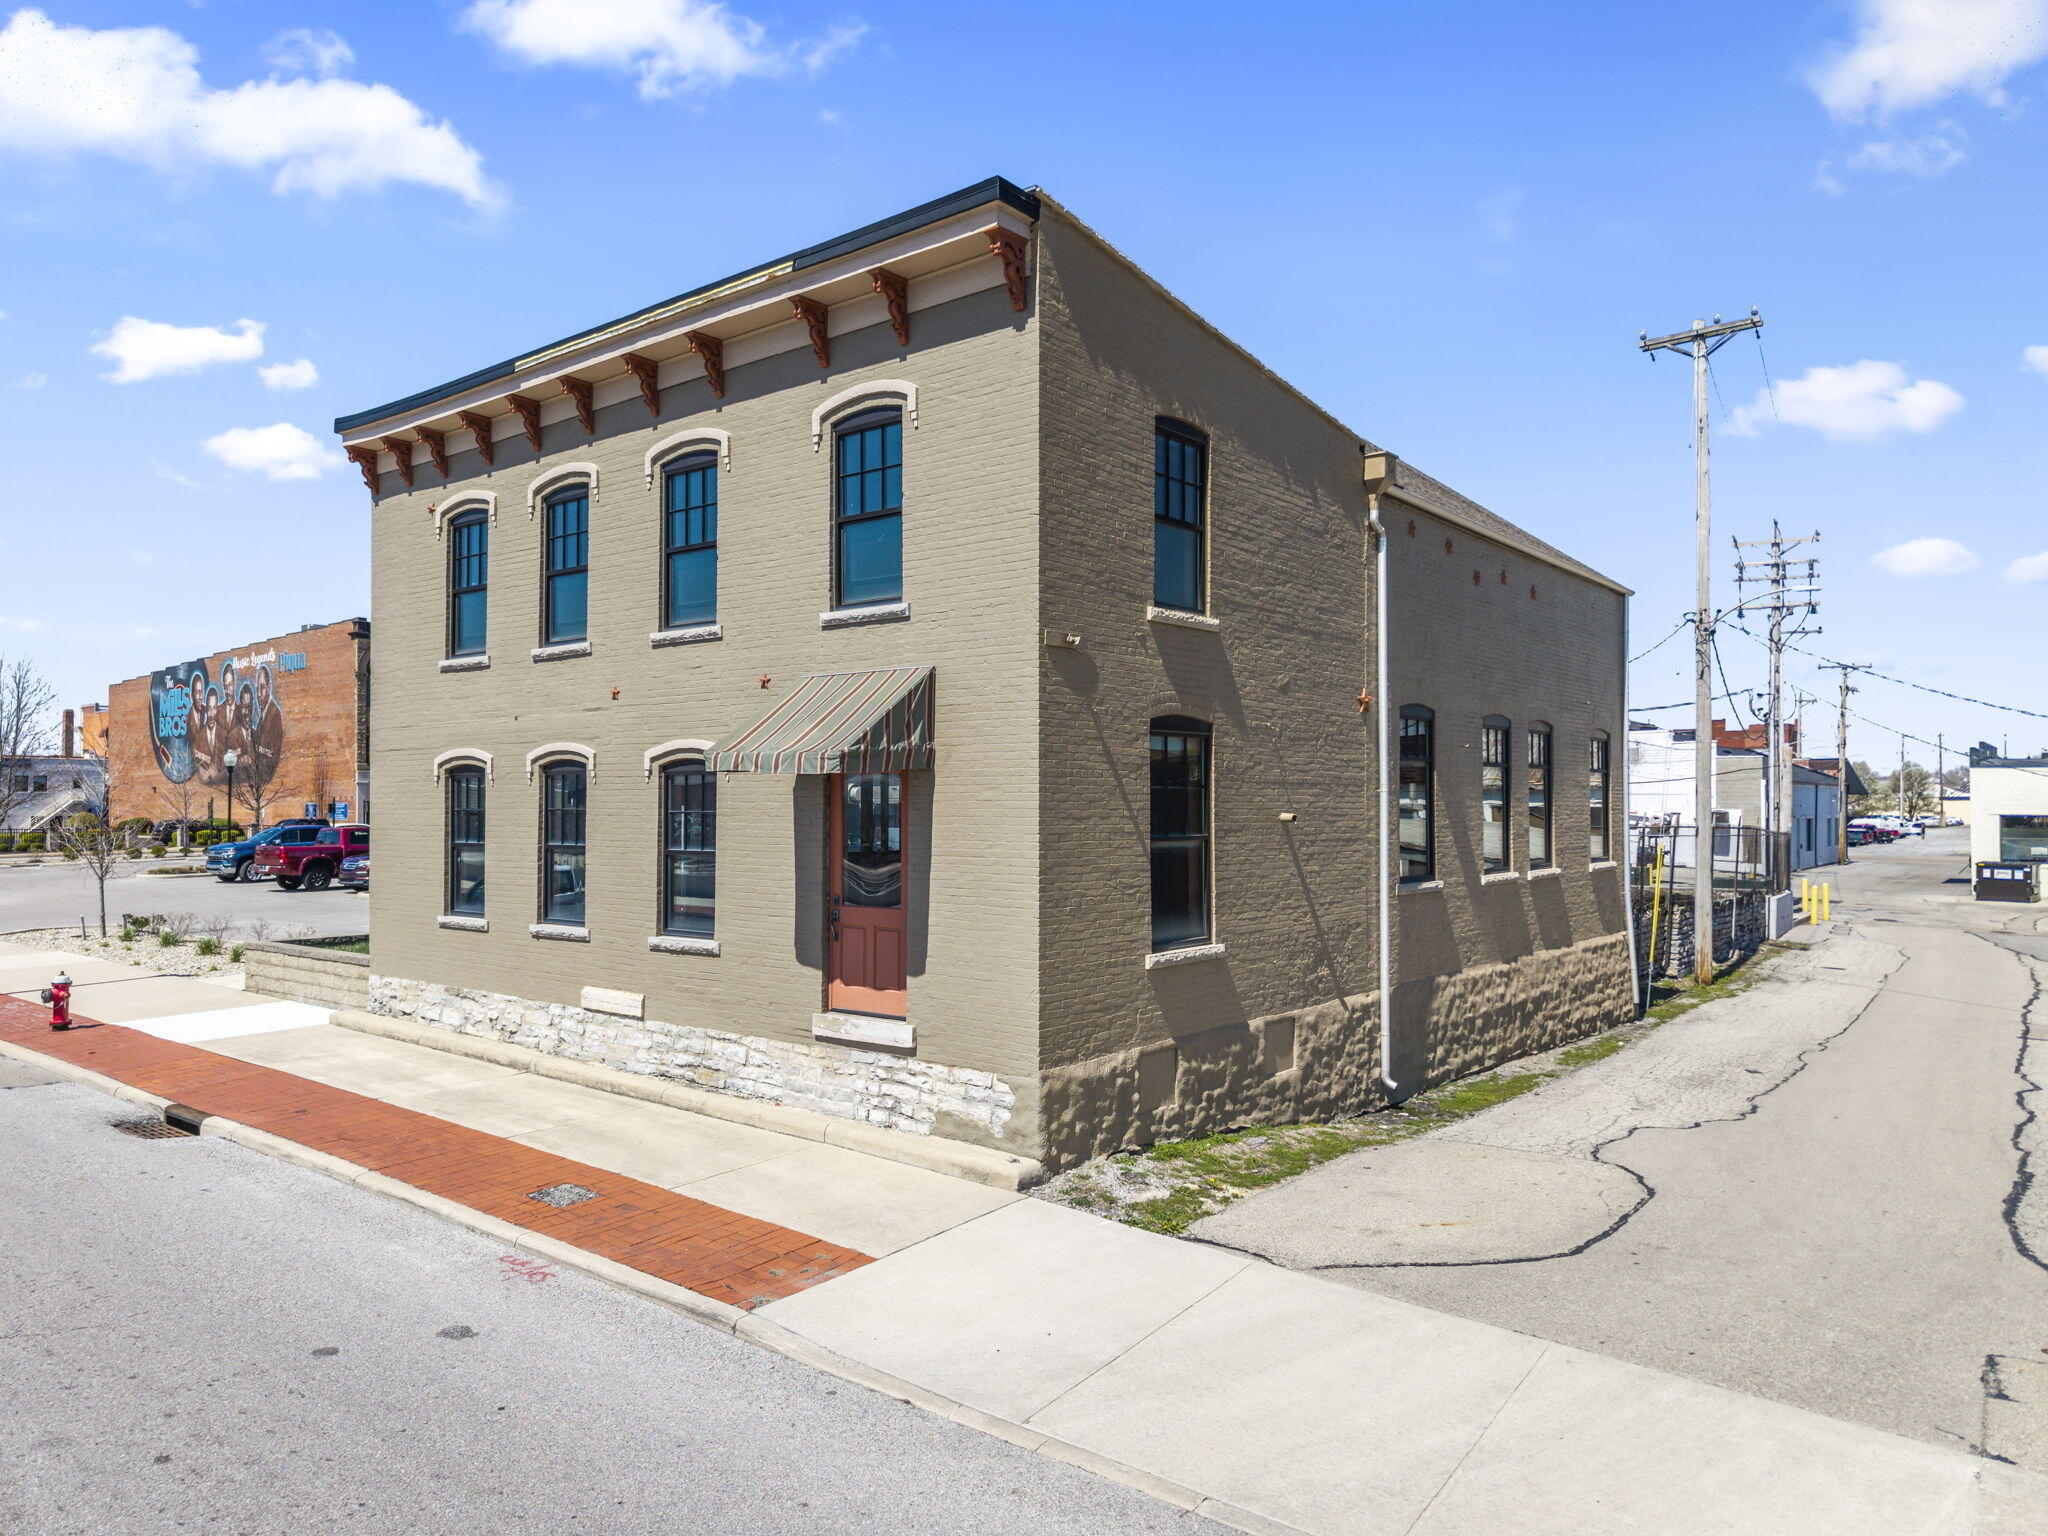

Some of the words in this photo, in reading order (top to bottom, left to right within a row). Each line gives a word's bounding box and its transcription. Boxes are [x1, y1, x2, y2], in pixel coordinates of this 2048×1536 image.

[251, 647, 276, 667] Legends
[278, 650, 307, 675] Piqua
[158, 716, 188, 737] BROS
